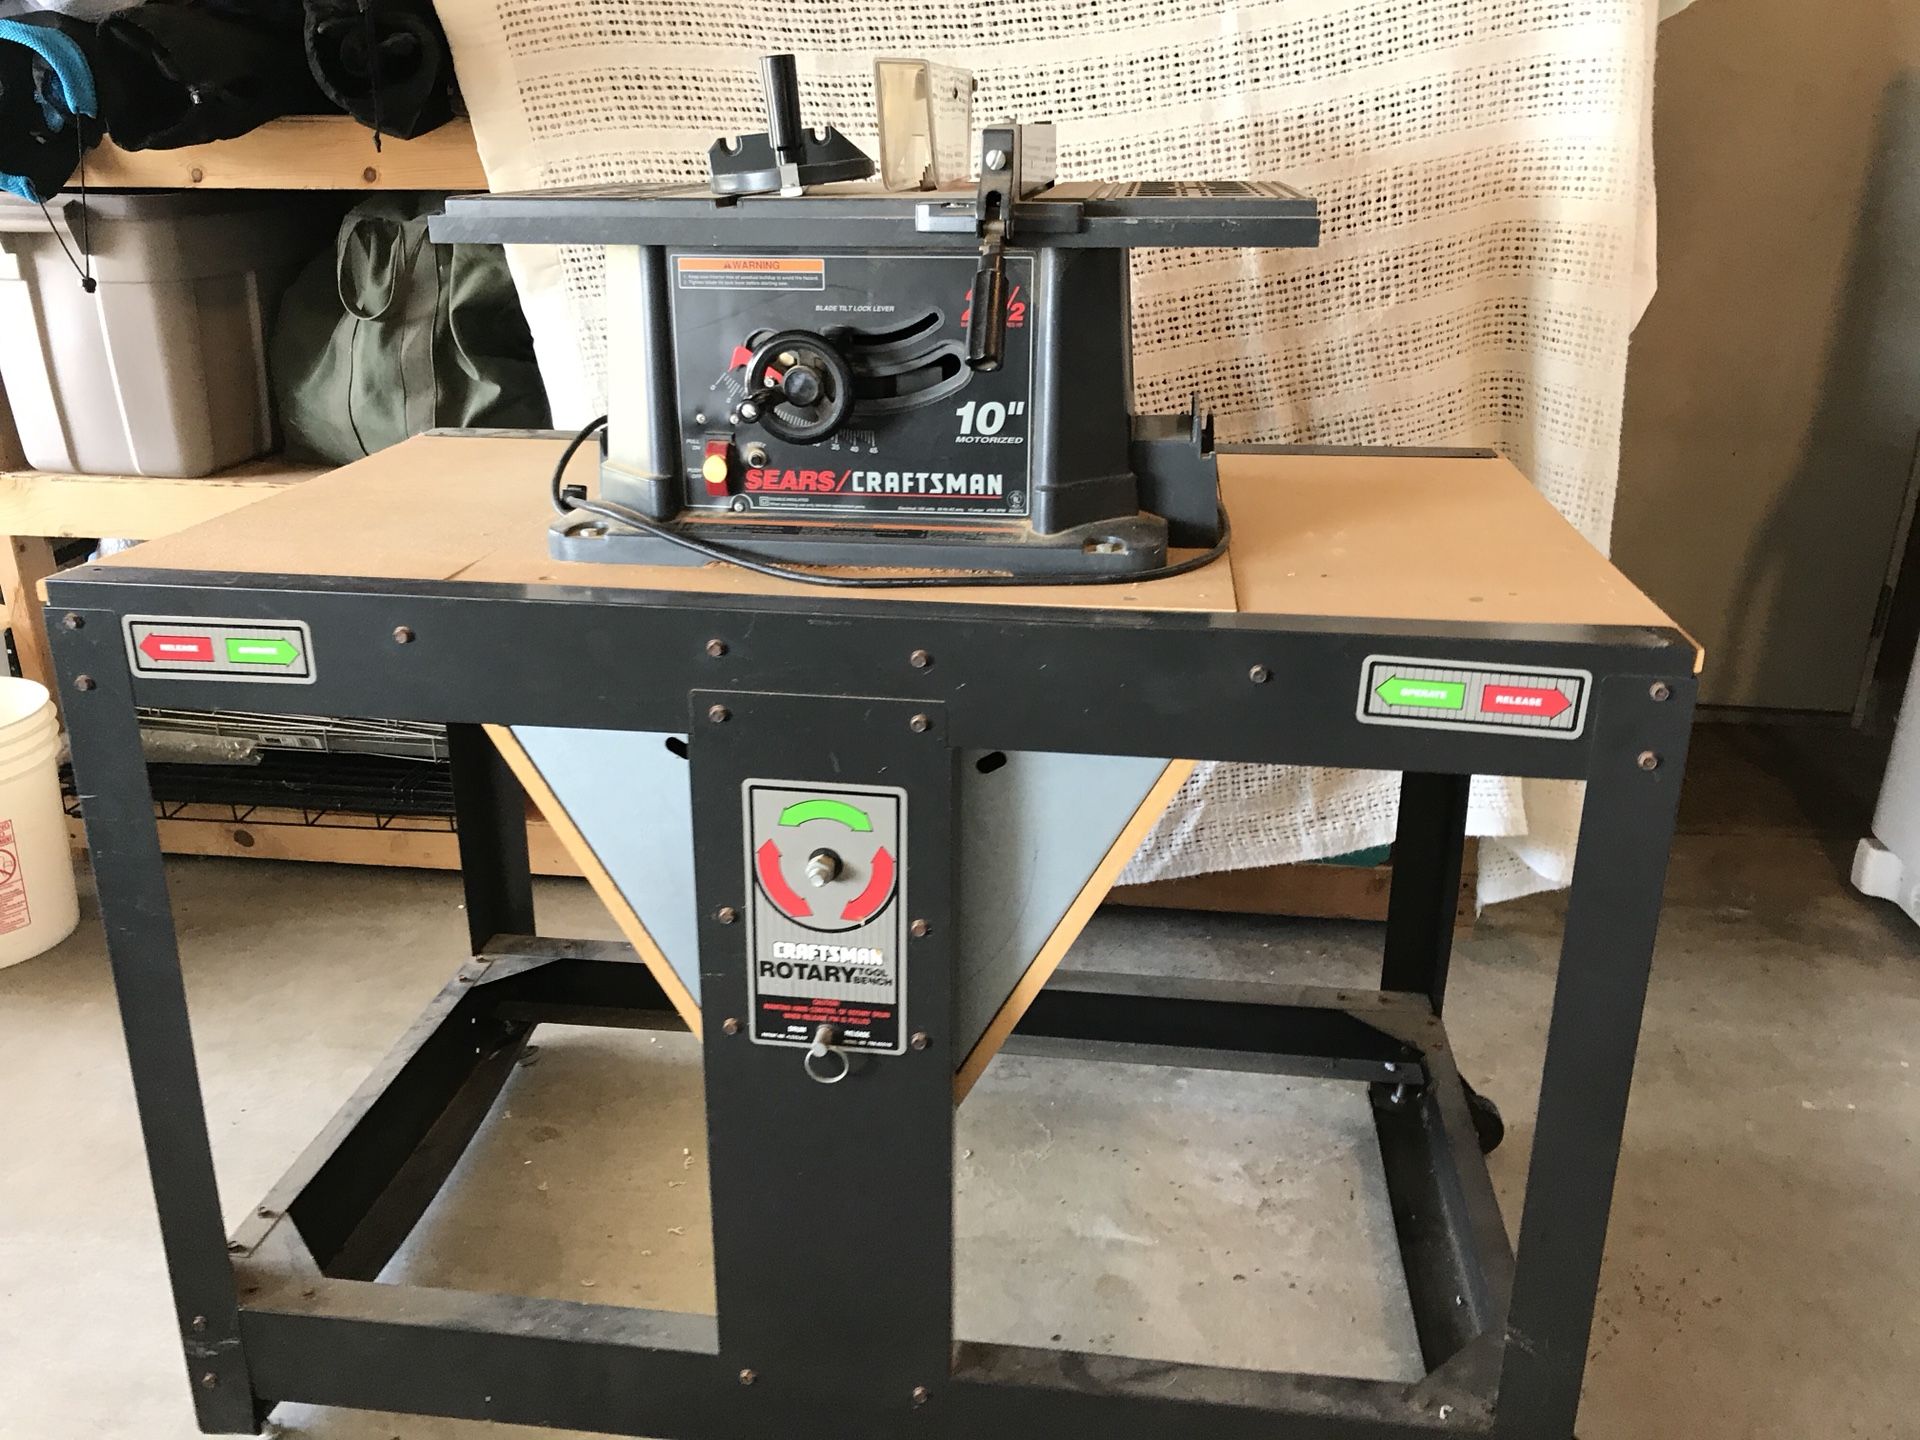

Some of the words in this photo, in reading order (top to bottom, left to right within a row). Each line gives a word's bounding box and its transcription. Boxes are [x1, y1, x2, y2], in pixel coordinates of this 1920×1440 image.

[733, 260, 780, 270] WARNING
[955, 436, 1024, 444] MOTORIZED
[1495, 694, 1544, 707] RELEASE
[773, 941, 883, 966] CRAFTSMAN
[760, 960, 856, 984] ROTARY
[858, 967, 889, 978] TOOL
[854, 976, 893, 987] BENCH
